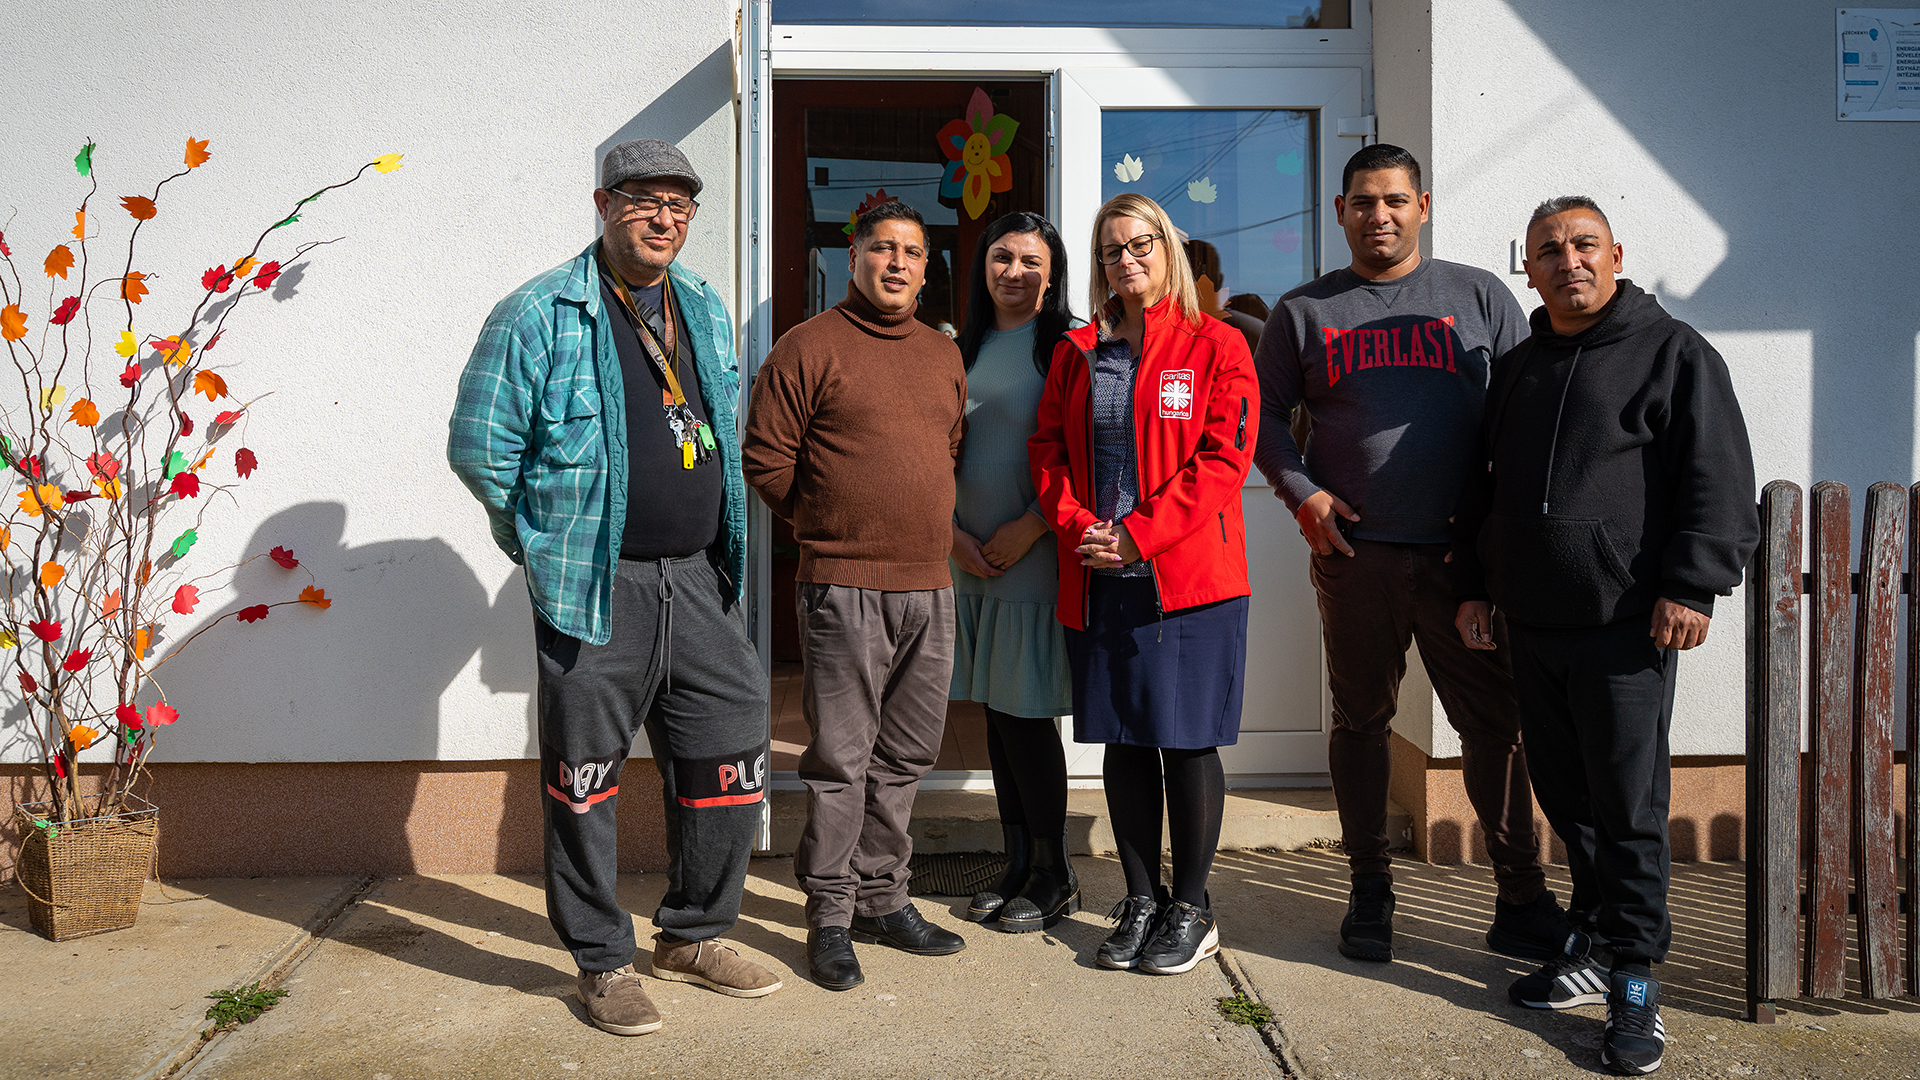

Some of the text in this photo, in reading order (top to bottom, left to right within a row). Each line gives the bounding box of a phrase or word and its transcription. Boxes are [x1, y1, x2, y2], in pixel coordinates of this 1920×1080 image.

[1322, 315, 1457, 388] EVERLAST
[559, 760, 614, 798] PLAY
[718, 752, 765, 791] PLA
